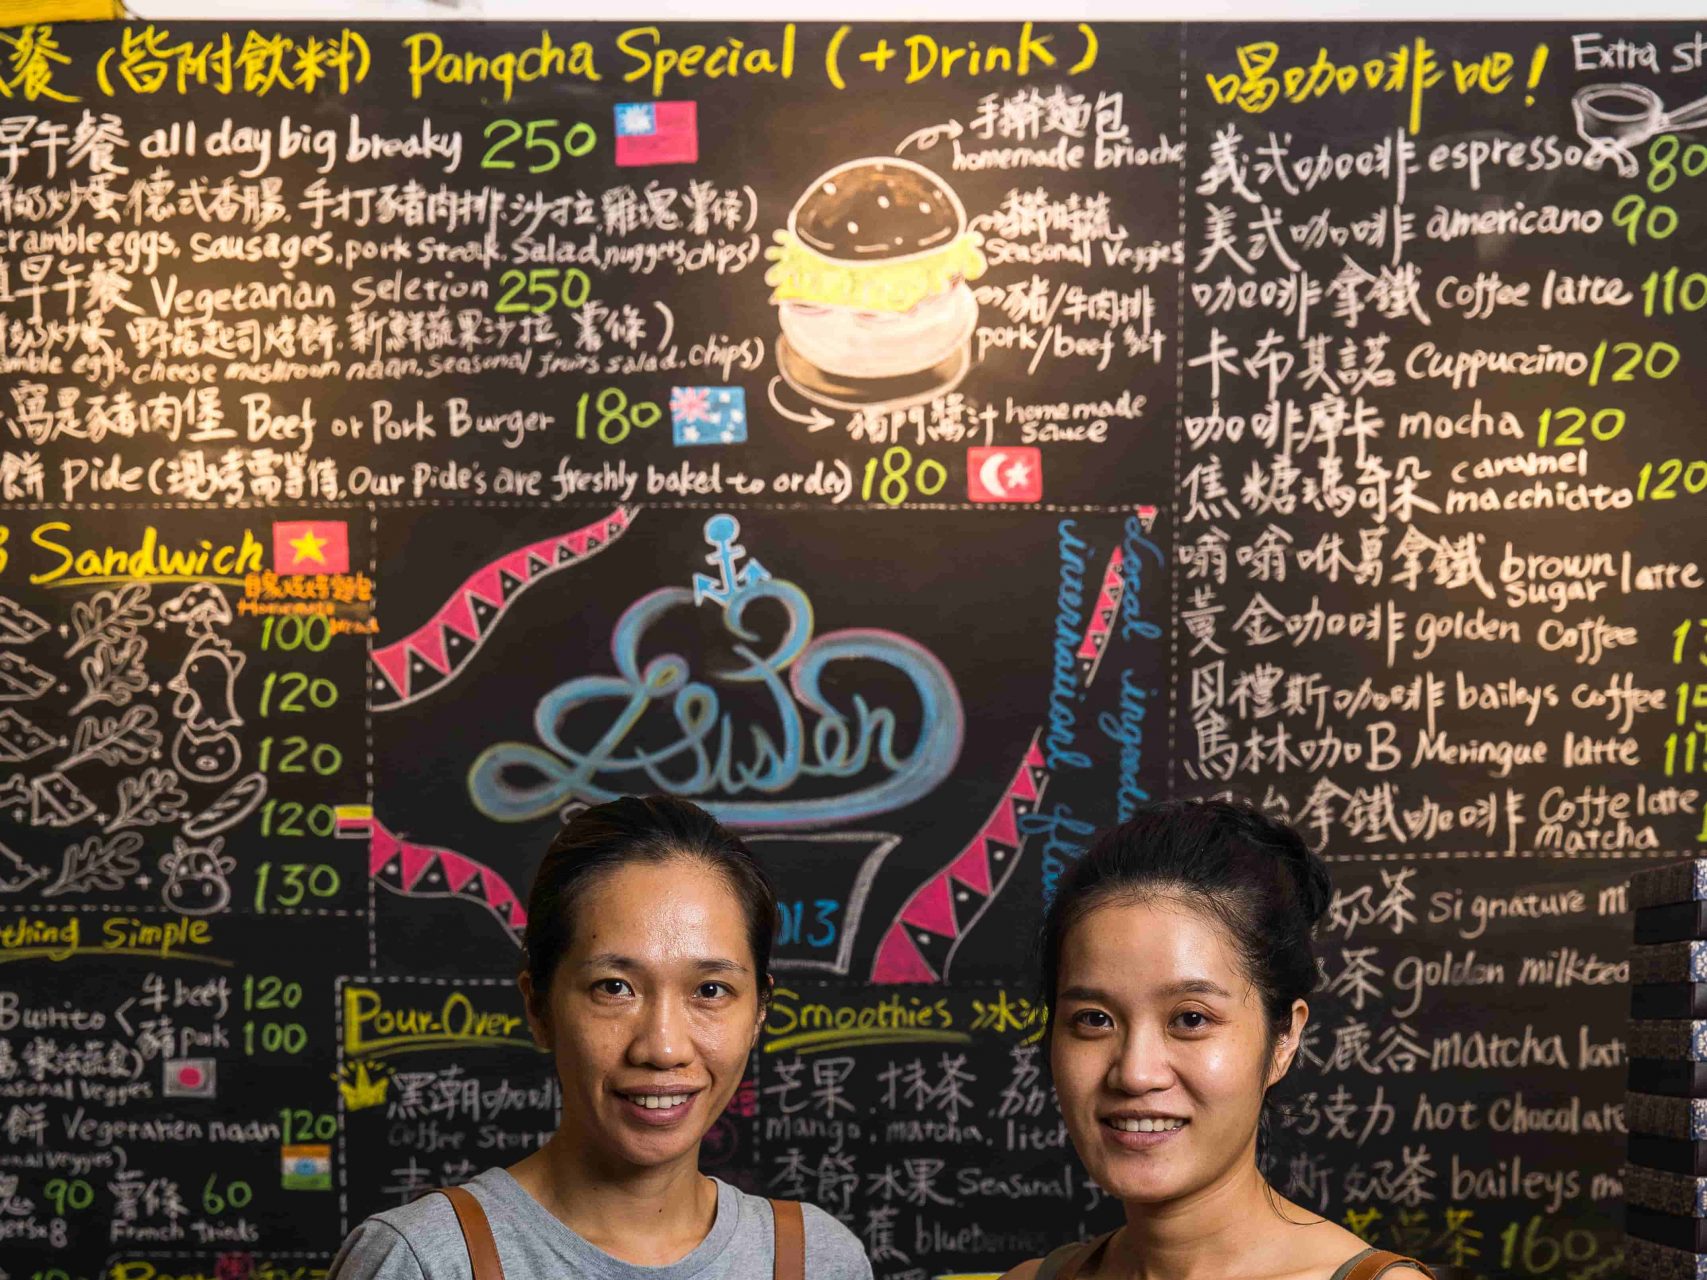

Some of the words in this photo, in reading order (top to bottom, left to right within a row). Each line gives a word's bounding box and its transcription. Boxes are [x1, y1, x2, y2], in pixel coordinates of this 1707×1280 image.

[0, 25, 83, 102] 餐
[403, 30, 601, 101] Pangcha
[616, 24, 796, 97] Special
[1571, 33, 1660, 74] Extra
[140, 120, 196, 158] all
[205, 118, 272, 178] day
[279, 115, 336, 174] big
[481, 119, 597, 173] 250
[952, 136, 1085, 171] homemade
[1094, 133, 1187, 170] brioche
[1429, 136, 1583, 191] espresso
[1646, 134, 1707, 193] 80
[345, 234, 412, 271] pork
[985, 237, 1091, 267] Seasonal
[1194, 199, 1419, 275] 美式咖啡
[1426, 202, 1603, 242] americano
[1611, 194, 1679, 246] 90
[151, 271, 336, 325] Vegetarian
[495, 268, 591, 313] 250
[1641, 266, 1707, 317] 110
[1588, 340, 1680, 387] 120
[242, 392, 316, 452] Beef
[331, 413, 363, 438] or
[371, 399, 436, 445] Pork
[447, 397, 555, 450] Burger
[576, 387, 662, 445] 180
[1022, 420, 1108, 444] sauce
[1399, 398, 1524, 439] mocha
[1537, 407, 1625, 447] 120
[493, 466, 541, 496] are
[553, 455, 639, 501] freshly
[647, 461, 722, 496] baked
[862, 446, 947, 506] 180
[1446, 483, 1634, 514] macchiato
[1451, 449, 1588, 483] caramel
[1638, 459, 1707, 501] 120
[30, 521, 264, 585] Sandwich
[1501, 541, 1616, 583] brown
[1623, 550, 1704, 593] latte
[1504, 576, 1607, 612] sugar
[261, 614, 332, 652] 100
[1412, 606, 1520, 660] golden
[259, 672, 338, 716] 120
[258, 737, 342, 775] 120
[1564, 731, 1640, 768] latte
[1664, 732, 1707, 777] 11
[260, 799, 336, 837] 120
[255, 861, 340, 912] 130
[1326, 866, 1419, 941] 奶茶
[0, 916, 79, 961] thing
[103, 916, 213, 958] Simple
[243, 974, 302, 1011] 120
[1393, 950, 1504, 1018] golden
[765, 987, 953, 1034] Smoothies
[243, 1021, 307, 1055] 100
[1000, 1045, 1062, 1118] 荔
[278, 1108, 337, 1144] 120
[1412, 1092, 1479, 1132] hot
[44, 1178, 94, 1216] 90
[202, 1172, 252, 1215] 60
[1452, 1153, 1580, 1214] baileys
[1500, 1216, 1597, 1273] 160
